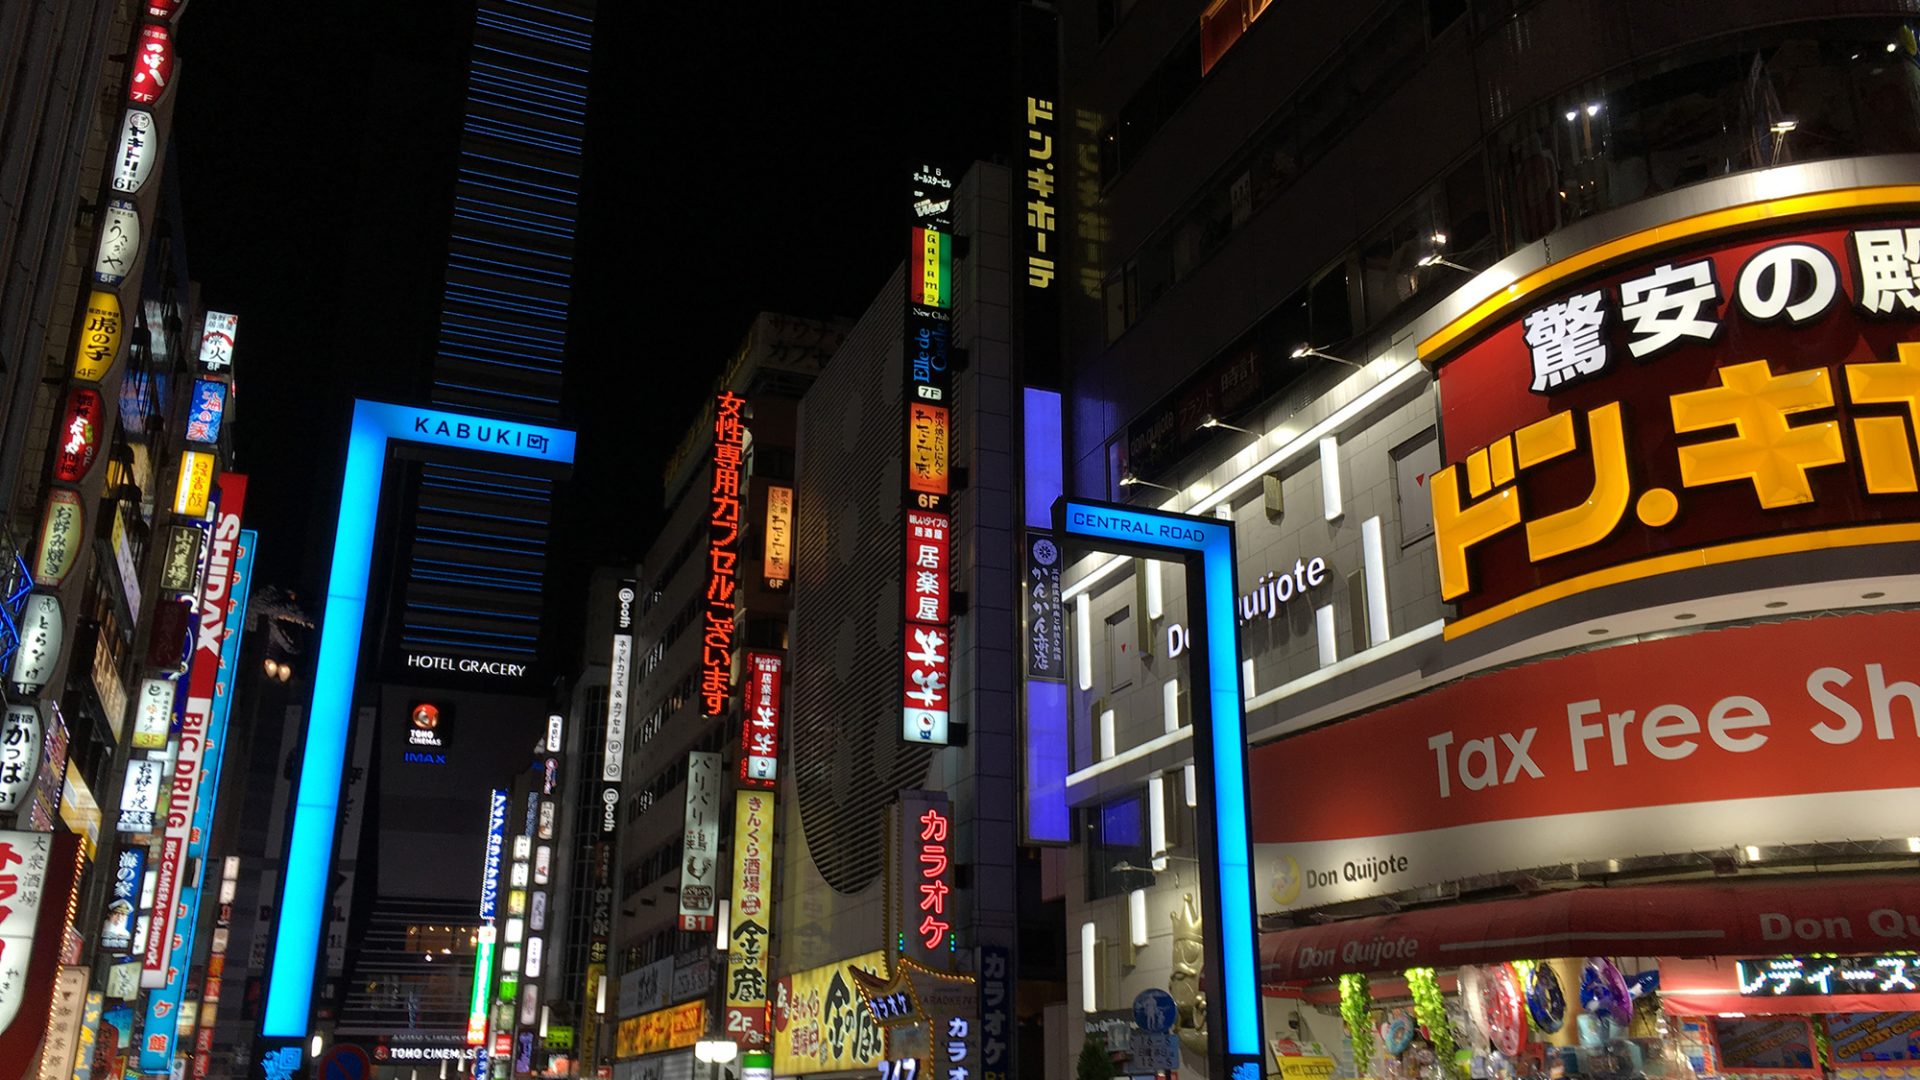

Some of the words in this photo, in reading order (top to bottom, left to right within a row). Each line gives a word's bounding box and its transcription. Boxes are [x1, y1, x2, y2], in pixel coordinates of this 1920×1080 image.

[132, 91, 153, 102] 7F
[113, 177, 140, 191] 6F
[100, 274, 117, 283] 5F
[912, 306, 931, 318] New
[931, 310, 950, 321] Club
[84, 317, 117, 361] 虎の子
[914, 327, 930, 349] de
[76, 367, 97, 377] 4F
[913, 351, 930, 384] Elle
[920, 387, 940, 399] 7F
[917, 493, 940, 509] 6F
[1073, 512, 1154, 536] CENTRAL
[1160, 524, 1205, 543] ROAD
[196, 512, 241, 657] SHIDAX
[769, 578, 784, 589] 6F
[915, 544, 940, 622] 居楽屋
[618, 587, 634, 628] Booth
[1031, 566, 1051, 670] かんかん商店
[407, 655, 456, 672] HOTEL
[459, 658, 527, 677] GRACERY
[906, 628, 946, 707] 笑笑
[17, 683, 37, 694] 1F
[8, 712, 34, 724] 新宿
[180, 711, 204, 757] BIC
[408, 736, 443, 747] CINEMAS
[410, 729, 435, 740] TOHO
[1429, 726, 1546, 798] Tax
[1566, 693, 1771, 772] Free
[404, 751, 447, 765] IMAX
[166, 758, 199, 829] DRUG
[602, 787, 620, 832] Booth
[743, 796, 764, 894] きんくら酒場
[18, 836, 48, 907] 大衆酒場
[919, 808, 950, 949] カラオケ
[1306, 867, 1338, 889] Don
[1343, 853, 1409, 881] Quijote
[684, 916, 707, 930] B1
[1759, 912, 1853, 941] Don
[729, 919, 768, 1002] 金の蔵
[1299, 944, 1335, 969] Don
[1342, 936, 1418, 967] Quijote
[869, 991, 908, 1021] カラオケ
[983, 953, 1007, 1066] カラオケ
[390, 1047, 422, 1060] TOHO
